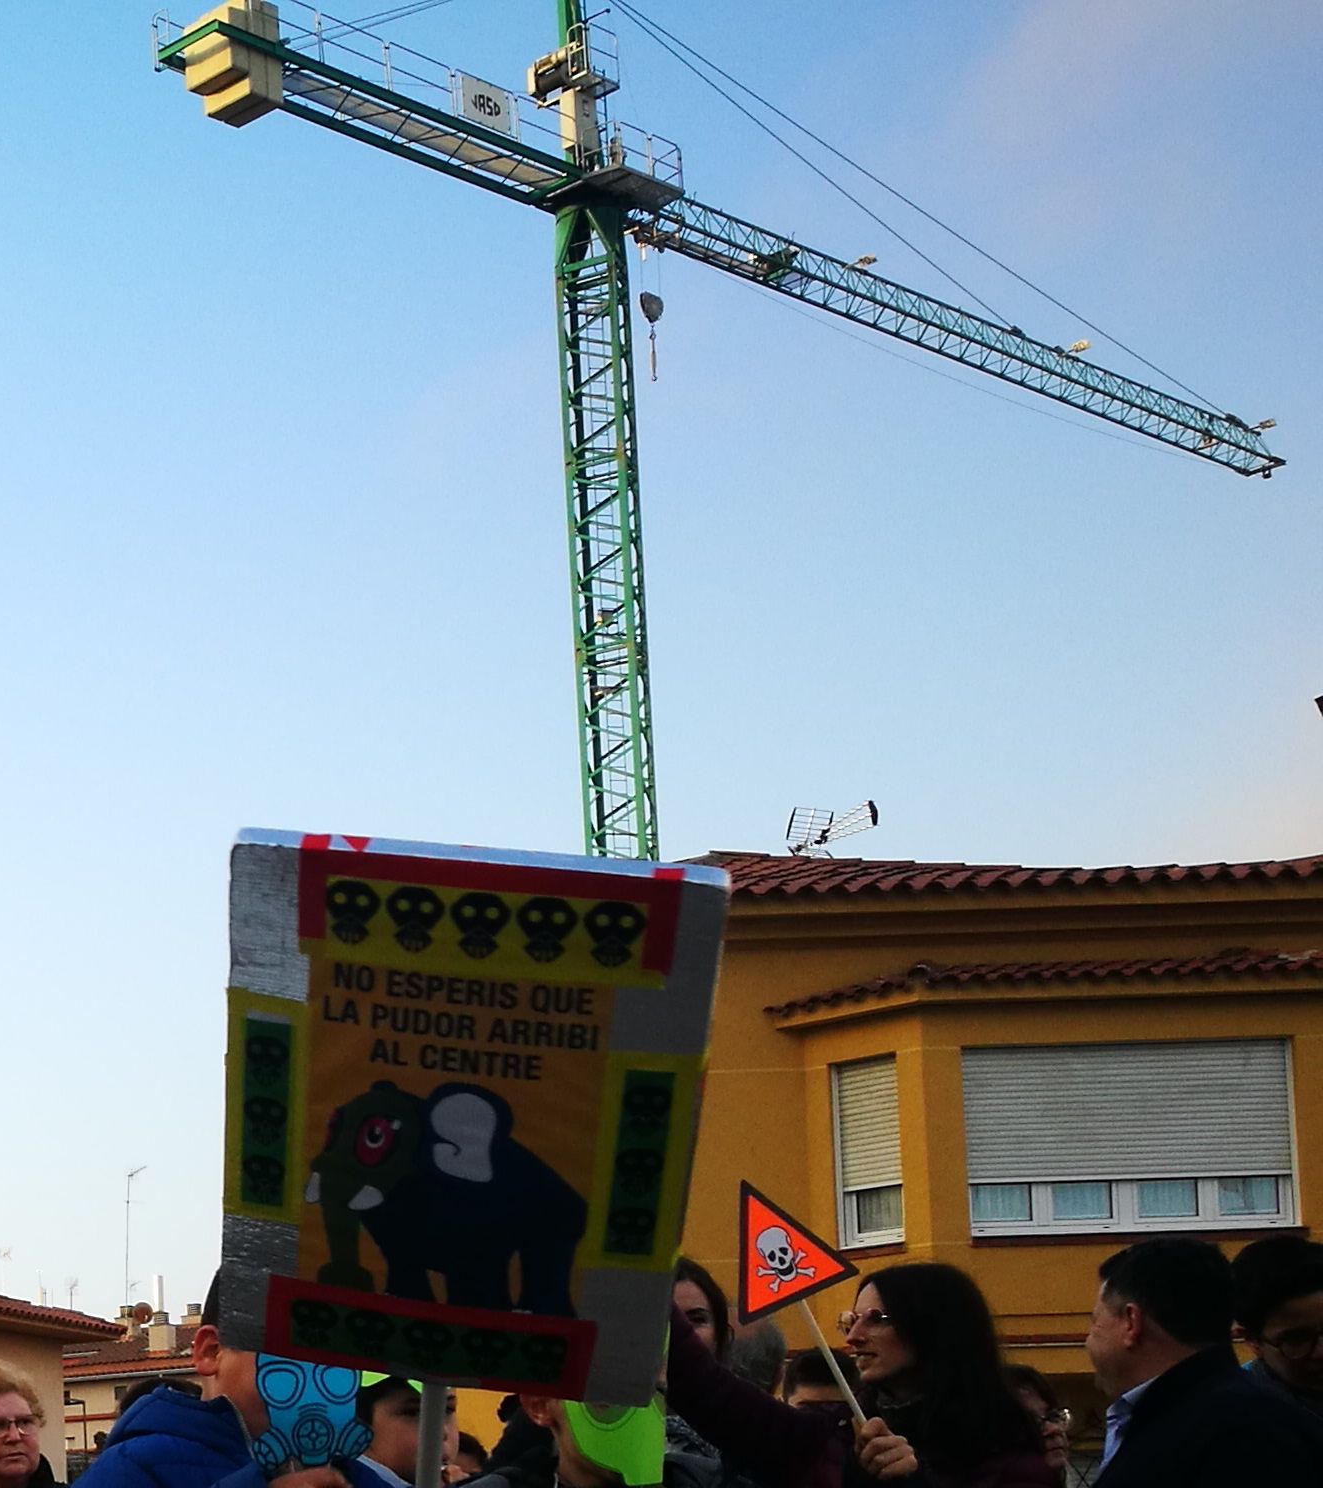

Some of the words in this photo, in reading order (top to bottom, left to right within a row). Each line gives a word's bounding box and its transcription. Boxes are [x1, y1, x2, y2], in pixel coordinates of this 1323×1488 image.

[334, 962, 375, 993] NO
[386, 970, 518, 1010] ESPERIS
[530, 985, 596, 1015] QUE
[323, 996, 360, 1026] LA
[372, 1003, 476, 1041] PUDOR
[488, 1017, 599, 1050] ARRIBI
[370, 1038, 408, 1066] AL
[420, 1044, 542, 1081] CENTRE
